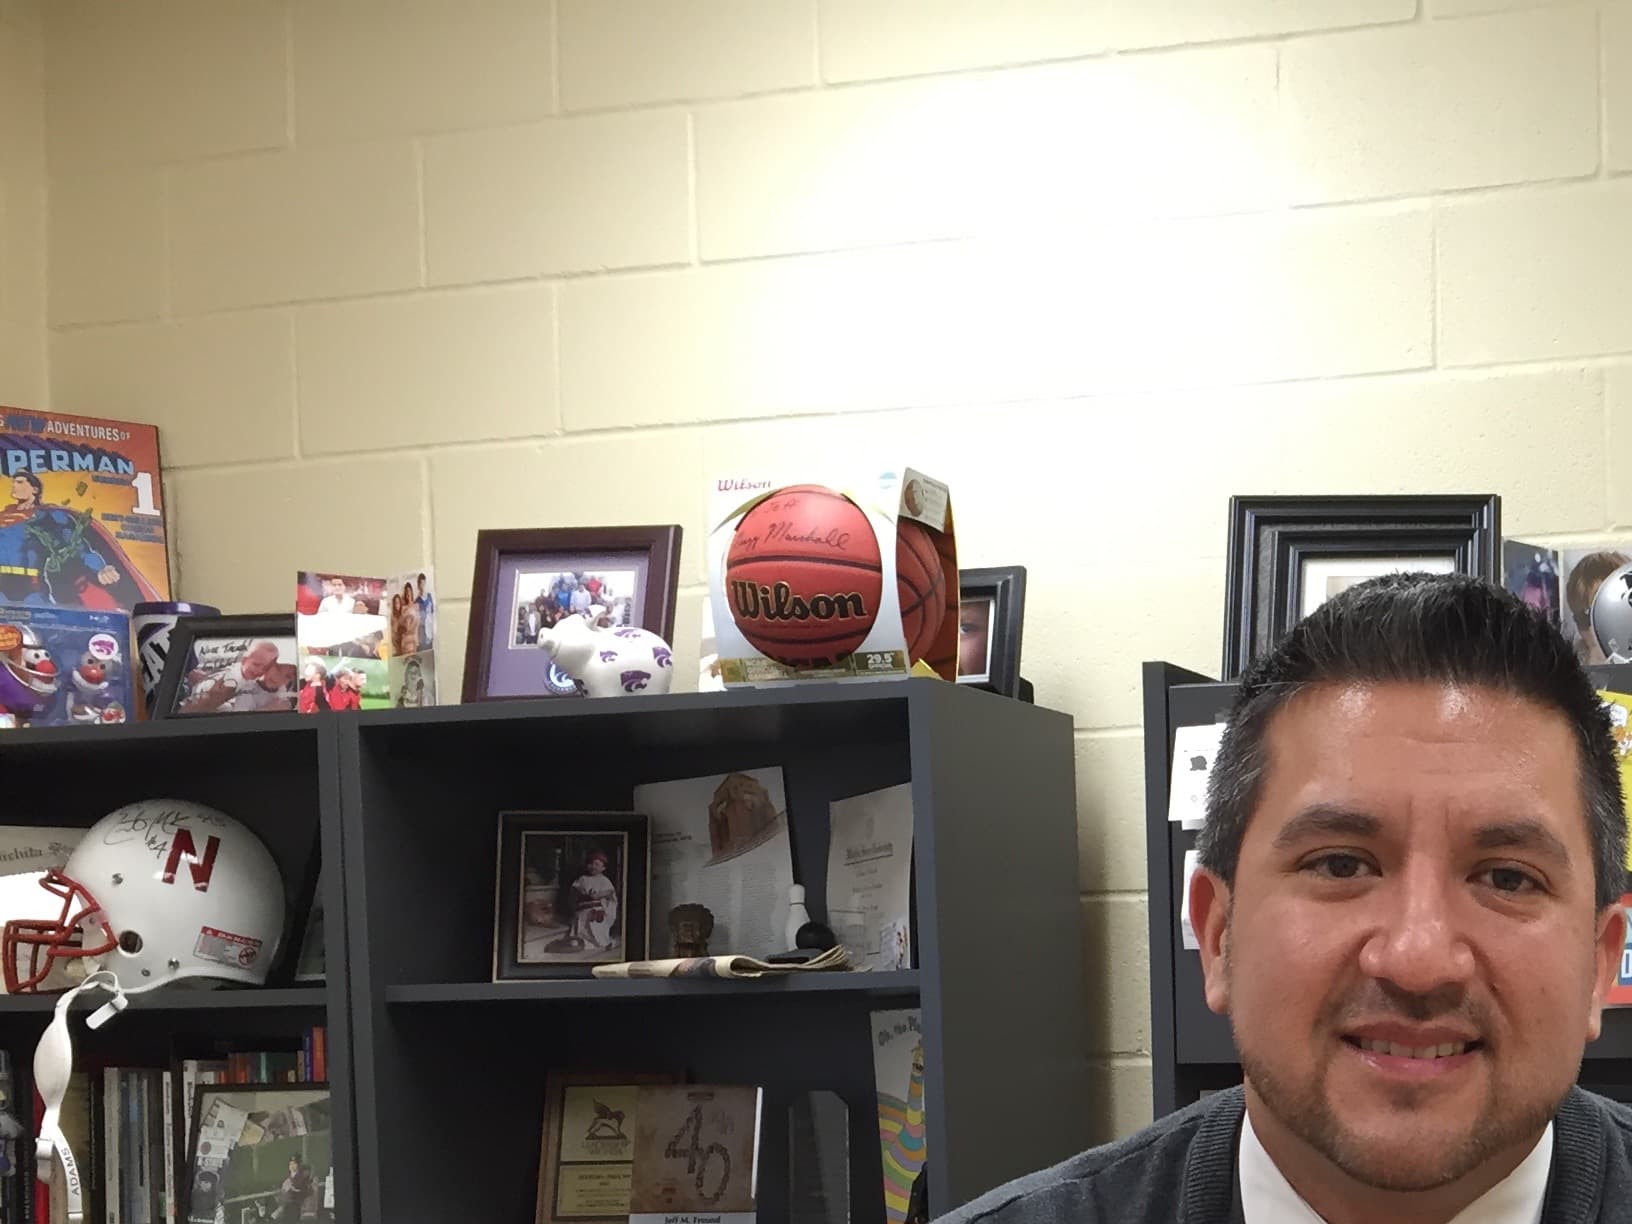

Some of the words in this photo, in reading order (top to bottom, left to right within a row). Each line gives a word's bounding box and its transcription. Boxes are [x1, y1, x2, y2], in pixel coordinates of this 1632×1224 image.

[47, 420, 120, 442] ADVENTURES
[0, 449, 134, 477] PERMAN
[132, 472, 161, 516] 1
[717, 478, 772, 492] Wilson
[731, 580, 868, 621] Wilson
[160, 828, 221, 893] N
[60, 1146, 81, 1197] ADAMS
